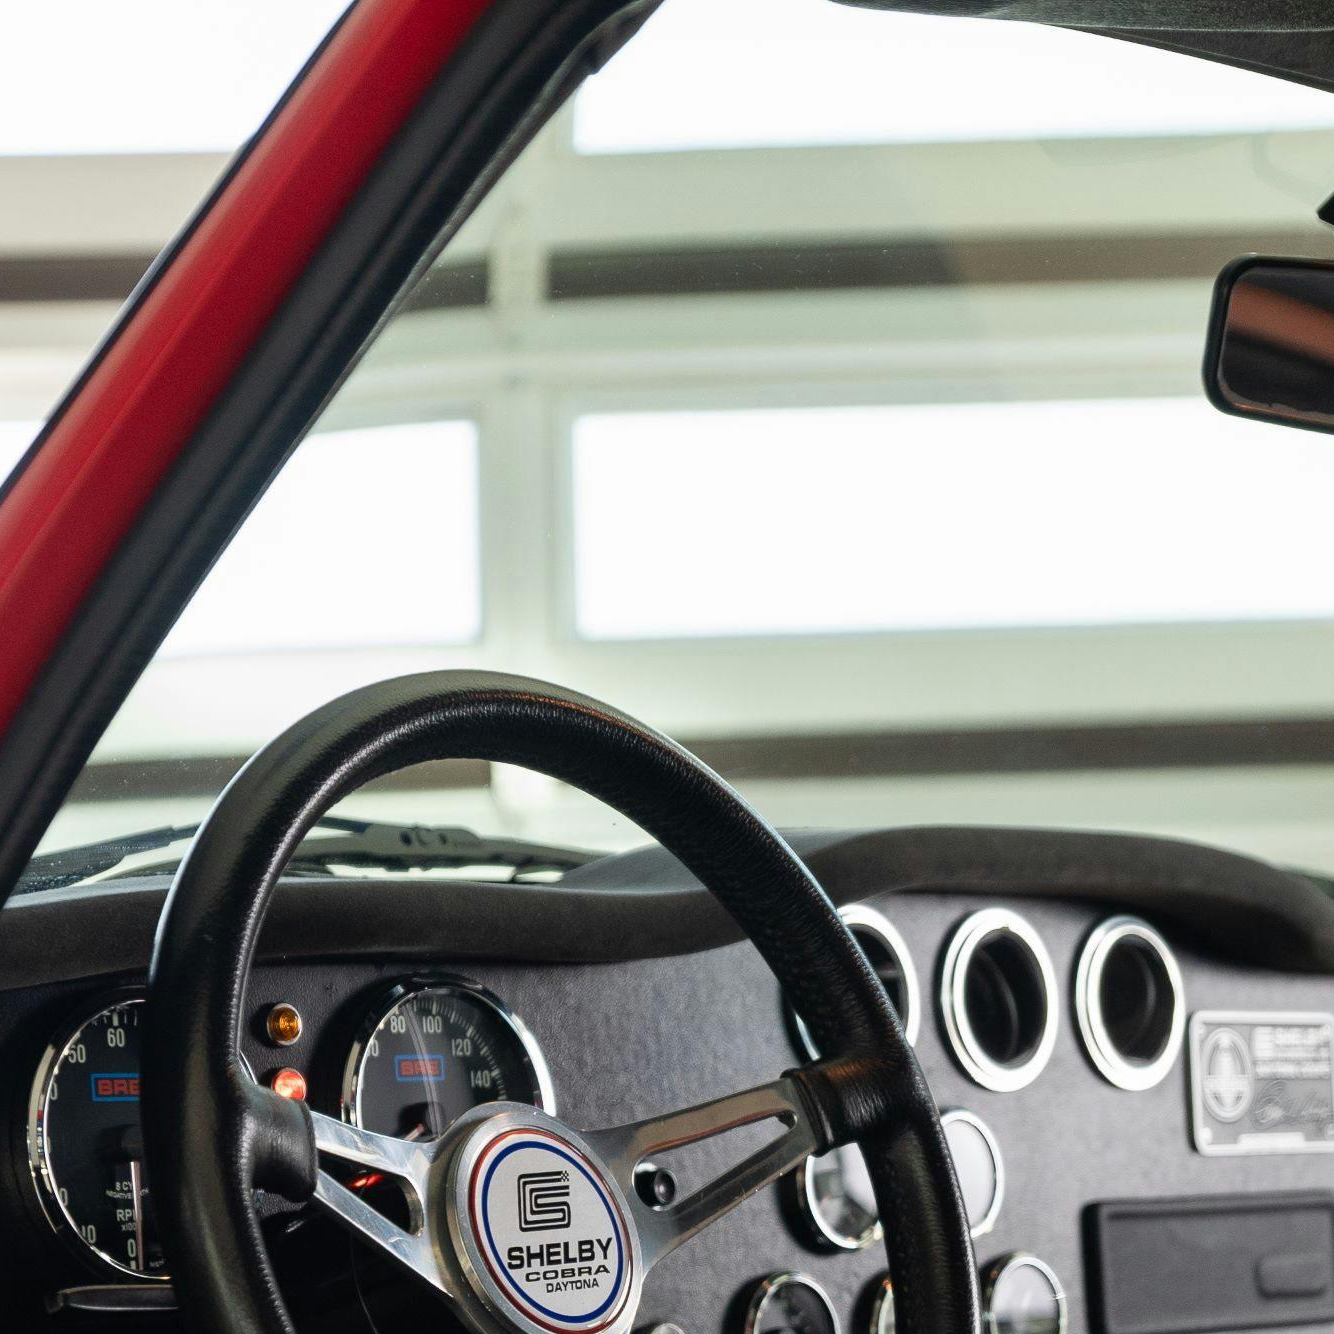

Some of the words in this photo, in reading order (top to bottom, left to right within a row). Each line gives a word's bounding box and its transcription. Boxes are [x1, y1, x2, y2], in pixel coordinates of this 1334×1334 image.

[390, 1015, 406, 1033] 80
[422, 1015, 442, 1033] 100
[107, 1028, 124, 1047] 60
[451, 1038, 471, 1056] 120
[69, 1044, 86, 1063] 50
[470, 1070, 491, 1088] 140
[81, 1225, 96, 1244] 10
[127, 1238, 136, 1258] 0
[507, 1237, 613, 1271] SHELBY
[525, 1264, 611, 1283] COBRA
[546, 1278, 599, 1294] DAYTONA
